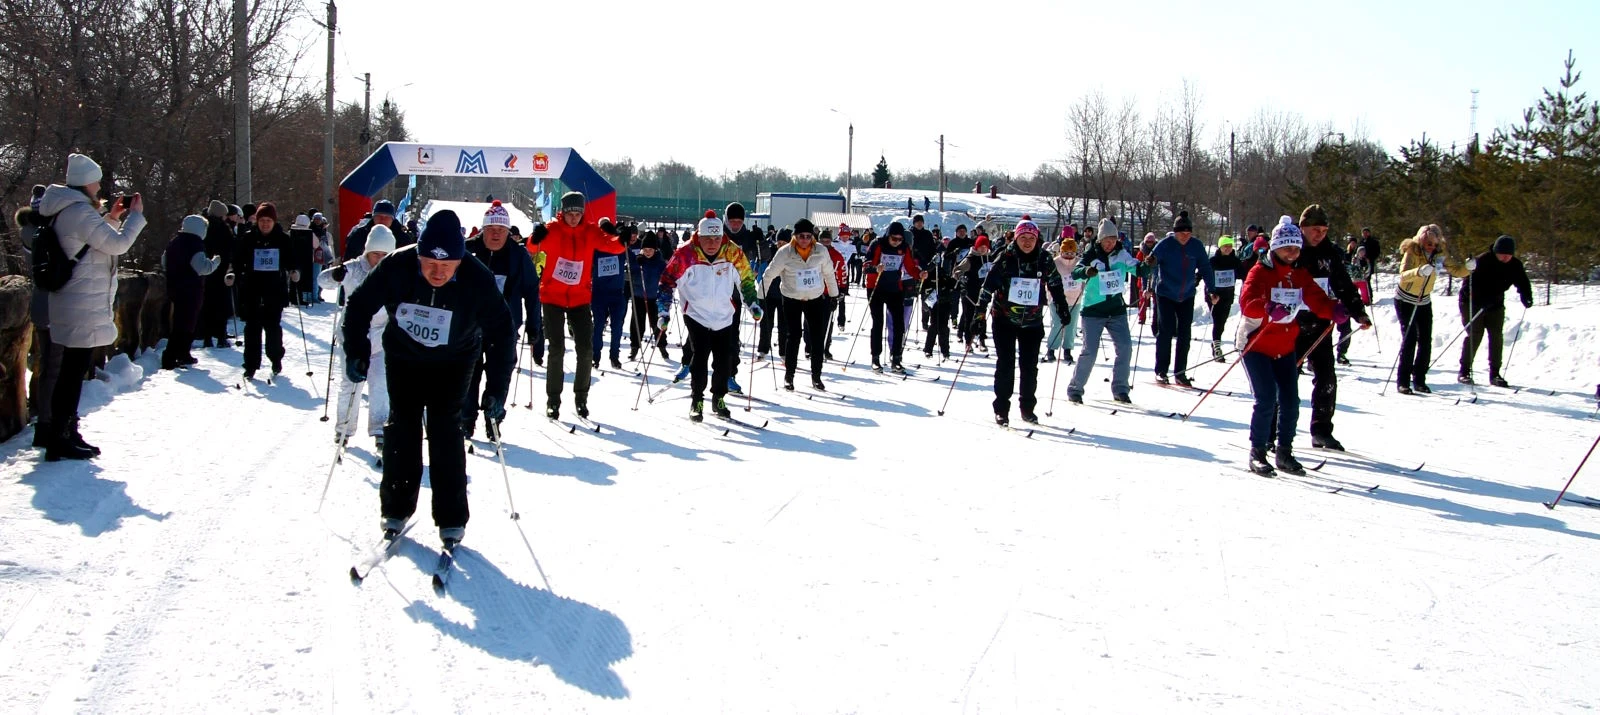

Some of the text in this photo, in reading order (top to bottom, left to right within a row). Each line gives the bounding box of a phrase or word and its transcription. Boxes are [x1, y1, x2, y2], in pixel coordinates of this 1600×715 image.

[602, 263, 617, 272] 2010
[558, 269, 578, 280] 2002
[803, 277, 815, 286] 961
[1106, 279, 1120, 289] 960
[1017, 289, 1032, 300] 910
[406, 320, 440, 341] 2005
